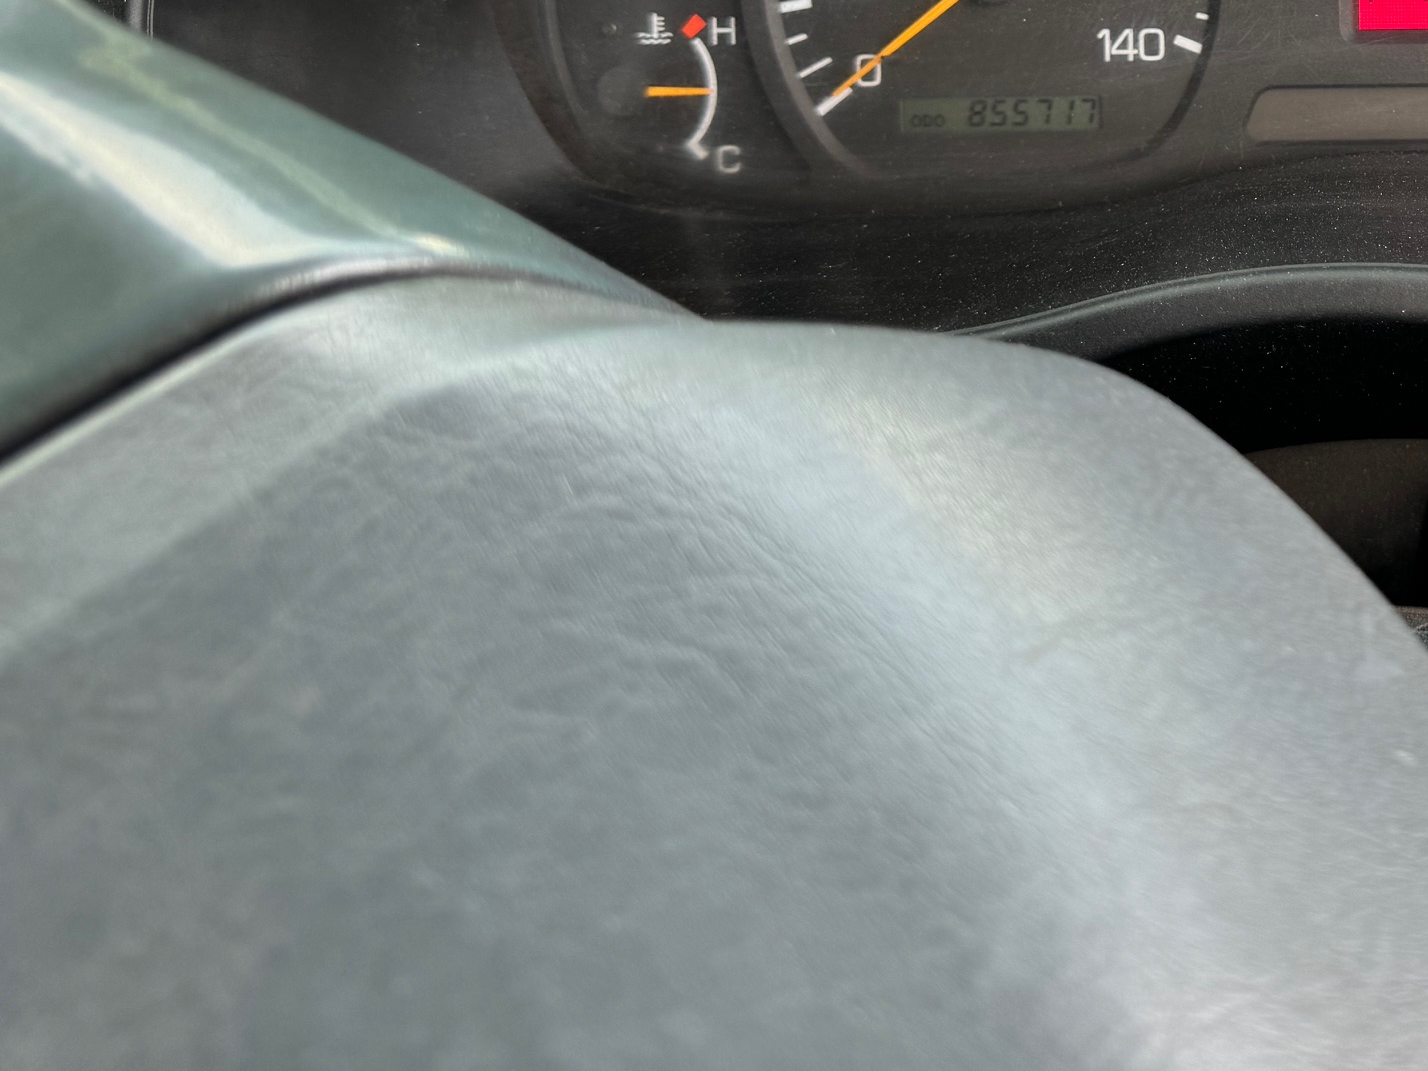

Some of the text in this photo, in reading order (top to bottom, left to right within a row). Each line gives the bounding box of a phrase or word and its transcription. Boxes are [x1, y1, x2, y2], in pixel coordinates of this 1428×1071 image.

[709, 17, 737, 45] H
[1098, 28, 1165, 61] 140
[857, 55, 882, 87] 0
[967, 99, 1097, 127] 855717
[717, 145, 743, 173] C
